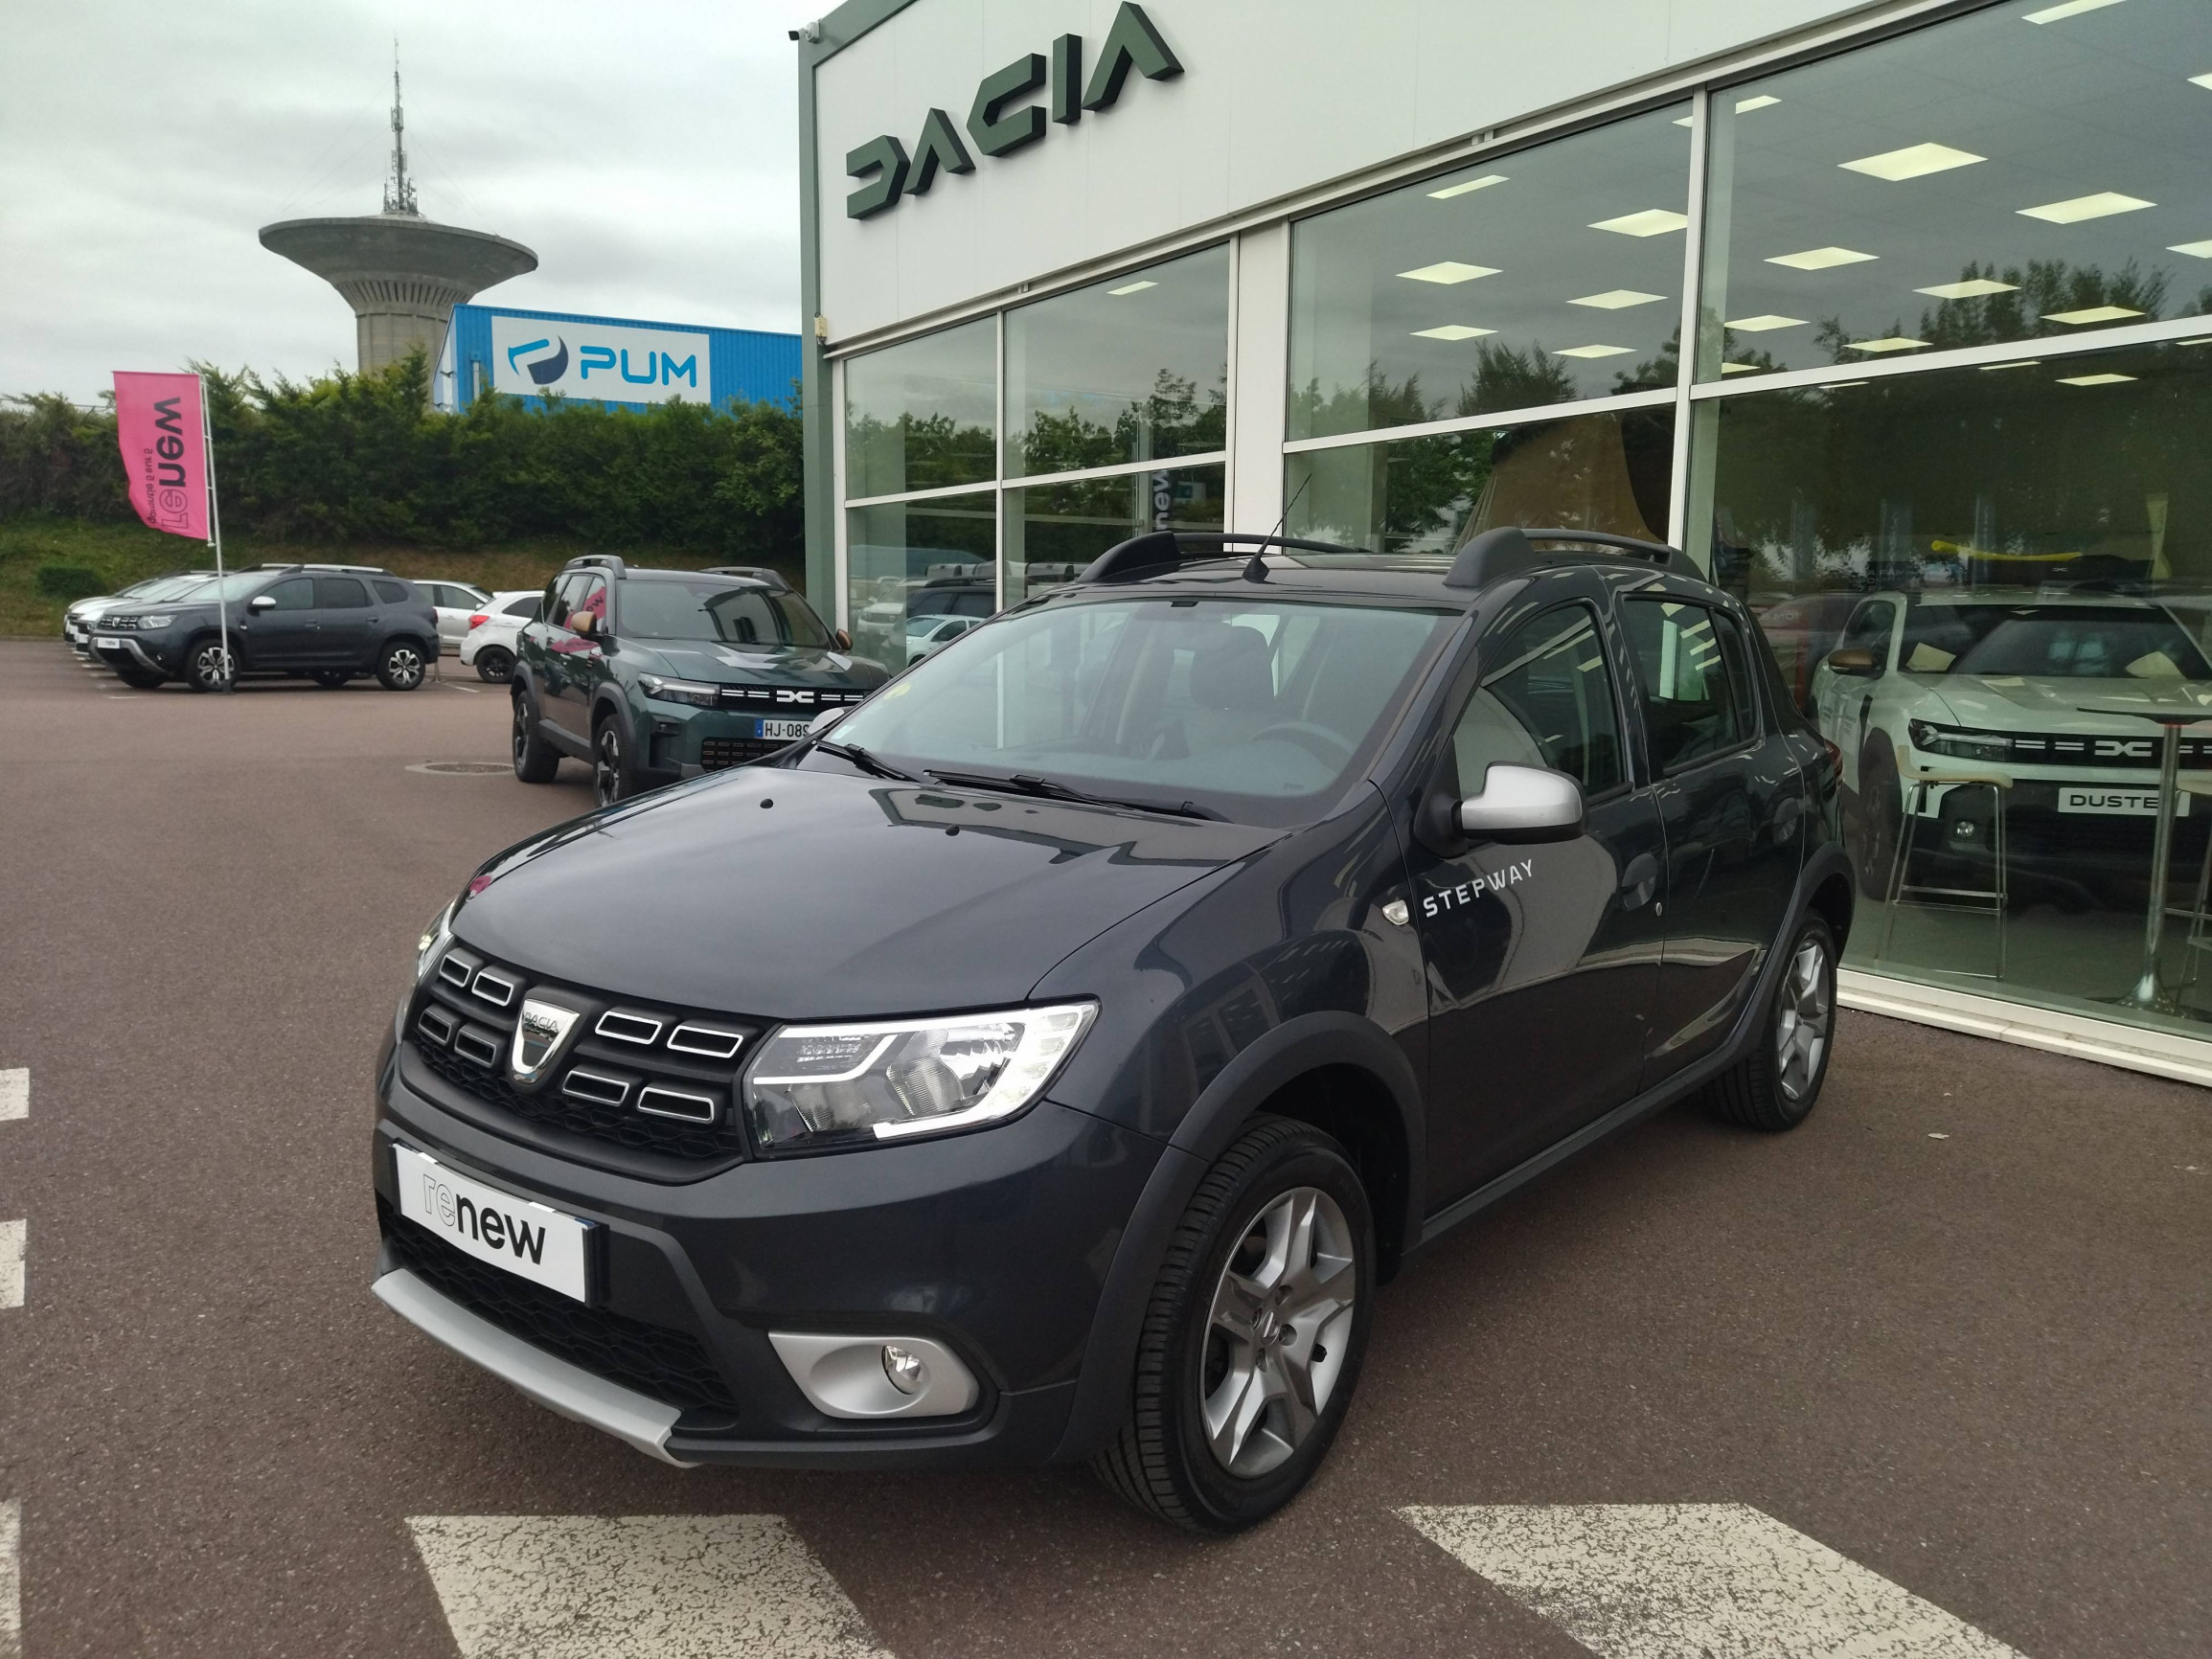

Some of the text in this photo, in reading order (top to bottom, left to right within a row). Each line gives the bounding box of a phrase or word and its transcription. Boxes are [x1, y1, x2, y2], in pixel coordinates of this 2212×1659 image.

[846, 1, 1184, 219] DACIA
[580, 345, 697, 388] PUM
[2069, 794, 2159, 809] DUSTE
[1423, 859, 1533, 918] STEPWAY
[523, 1011, 559, 1034] DACIA
[422, 1173, 546, 1265] renew
